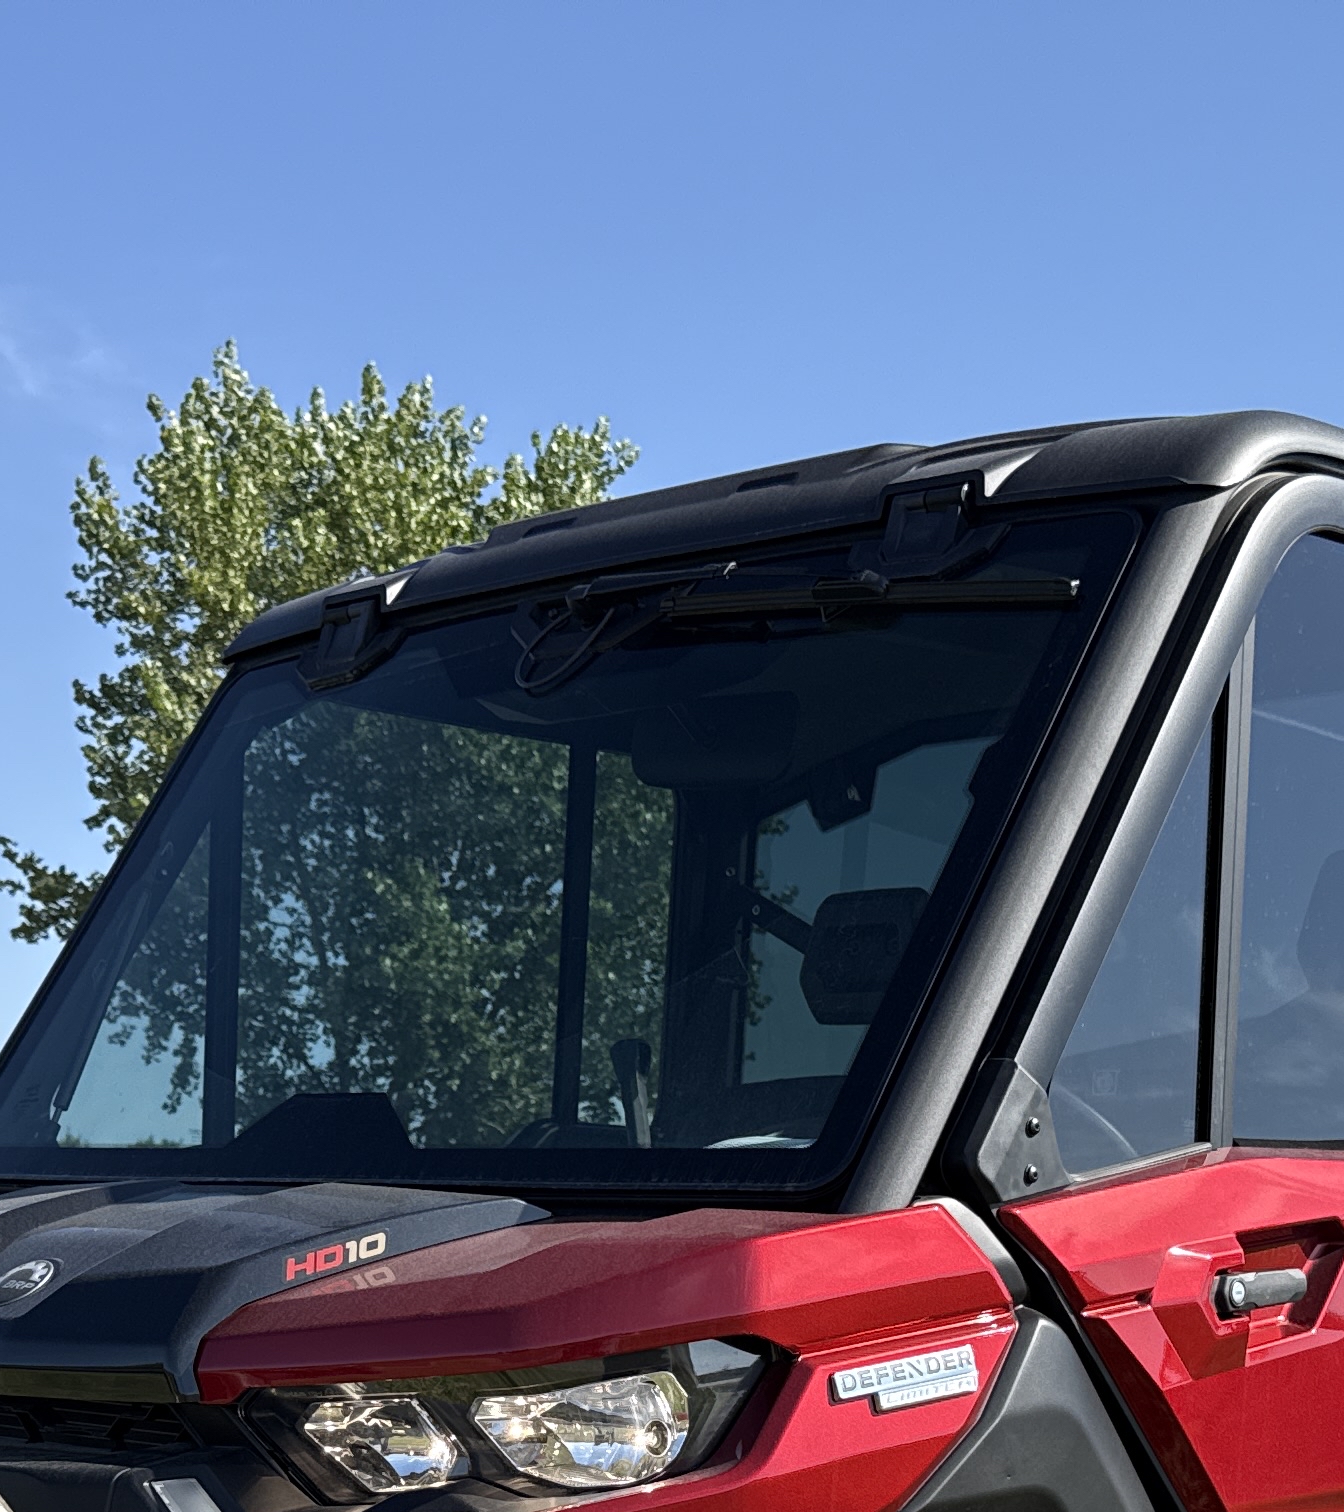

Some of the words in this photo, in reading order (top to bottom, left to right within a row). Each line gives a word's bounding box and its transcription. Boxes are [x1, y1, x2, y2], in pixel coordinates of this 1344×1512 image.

[286, 1232, 387, 1281] HD10
[1, 1280, 36, 1290] BRP
[839, 1350, 974, 1393] DEFENDER
